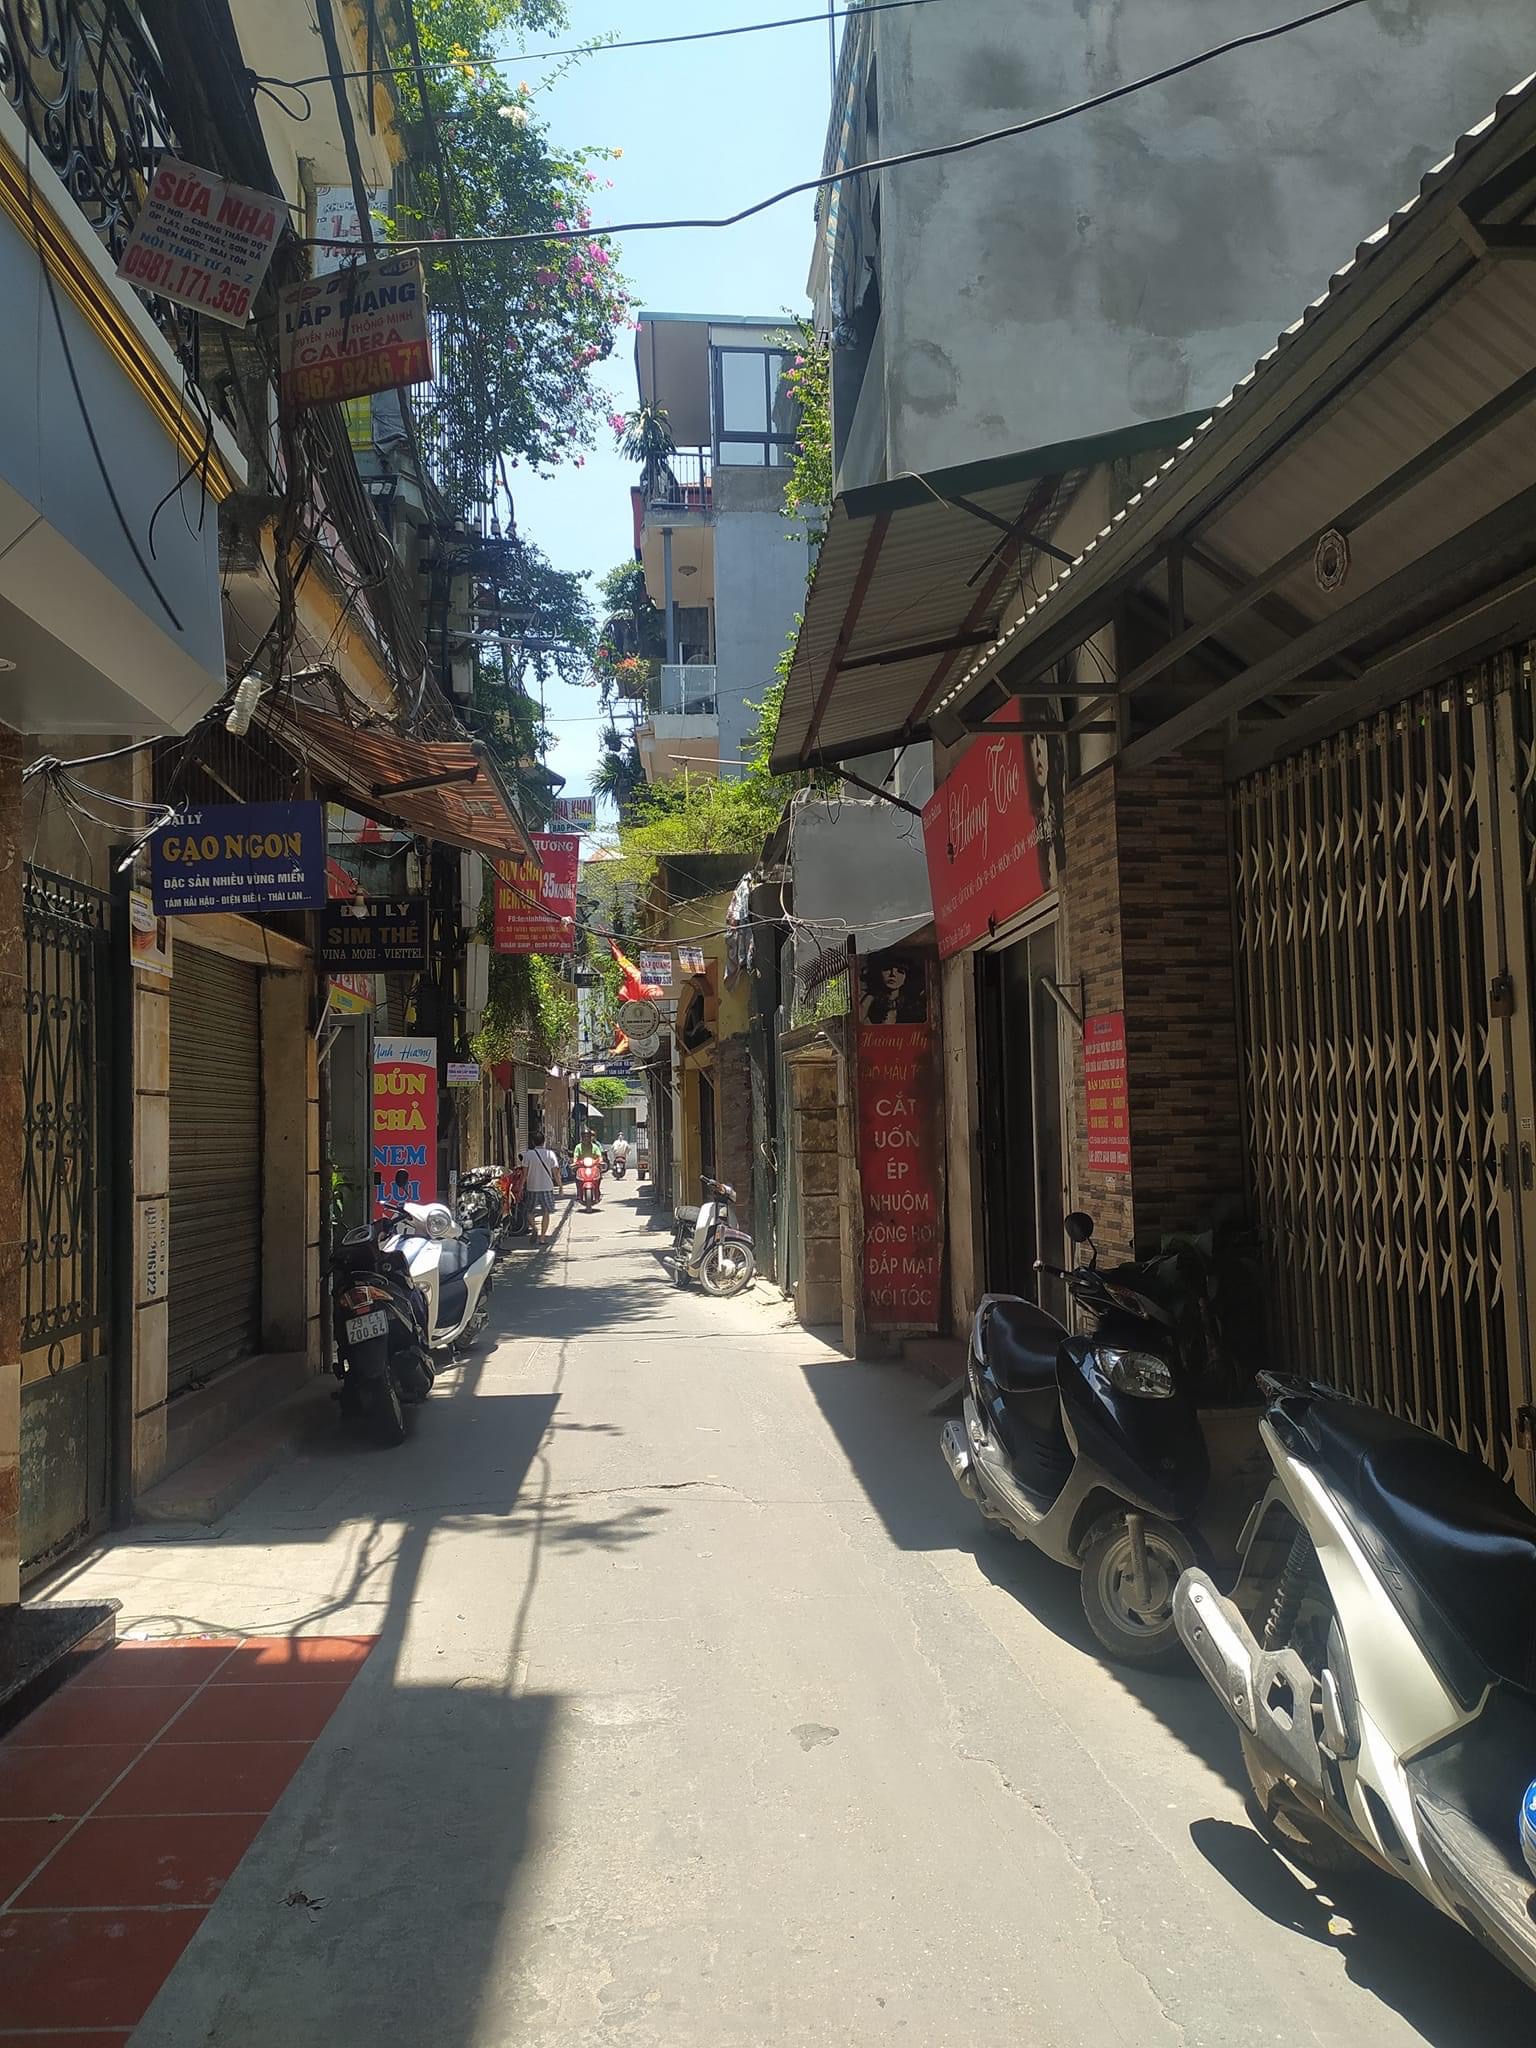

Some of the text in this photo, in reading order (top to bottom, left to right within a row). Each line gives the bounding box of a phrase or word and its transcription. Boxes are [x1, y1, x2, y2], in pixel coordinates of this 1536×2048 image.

[154, 172, 276, 241] SỬA NHÀ
[985, 736, 1020, 814] Tóc
[162, 831, 303, 866] GẠO NGON
[163, 867, 305, 890] ĐẶC SẢN NHIỀU VÙNG MIỀN
[385, 901, 410, 917] LÝ
[327, 920, 419, 945] SIM THẺ
[322, 948, 346, 960] VINA
[351, 948, 376, 959] MOBI
[384, 947, 425, 959] VIETTEL
[400, 1044, 432, 1063] Hương
[374, 1067, 426, 1095] BÚN
[374, 1101, 426, 1131] CHẢ
[875, 1091, 917, 1117] CẮT
[874, 1124, 920, 1150] UỐN
[373, 1144, 427, 1167] NEM
[886, 1156, 909, 1180] ÉP
[869, 1190, 930, 1216] NHUỘM
[866, 1221, 908, 1244] XÔNG
[869, 1249, 898, 1275] ĐẮP
[870, 1283, 932, 1306] NỐI TÓC
